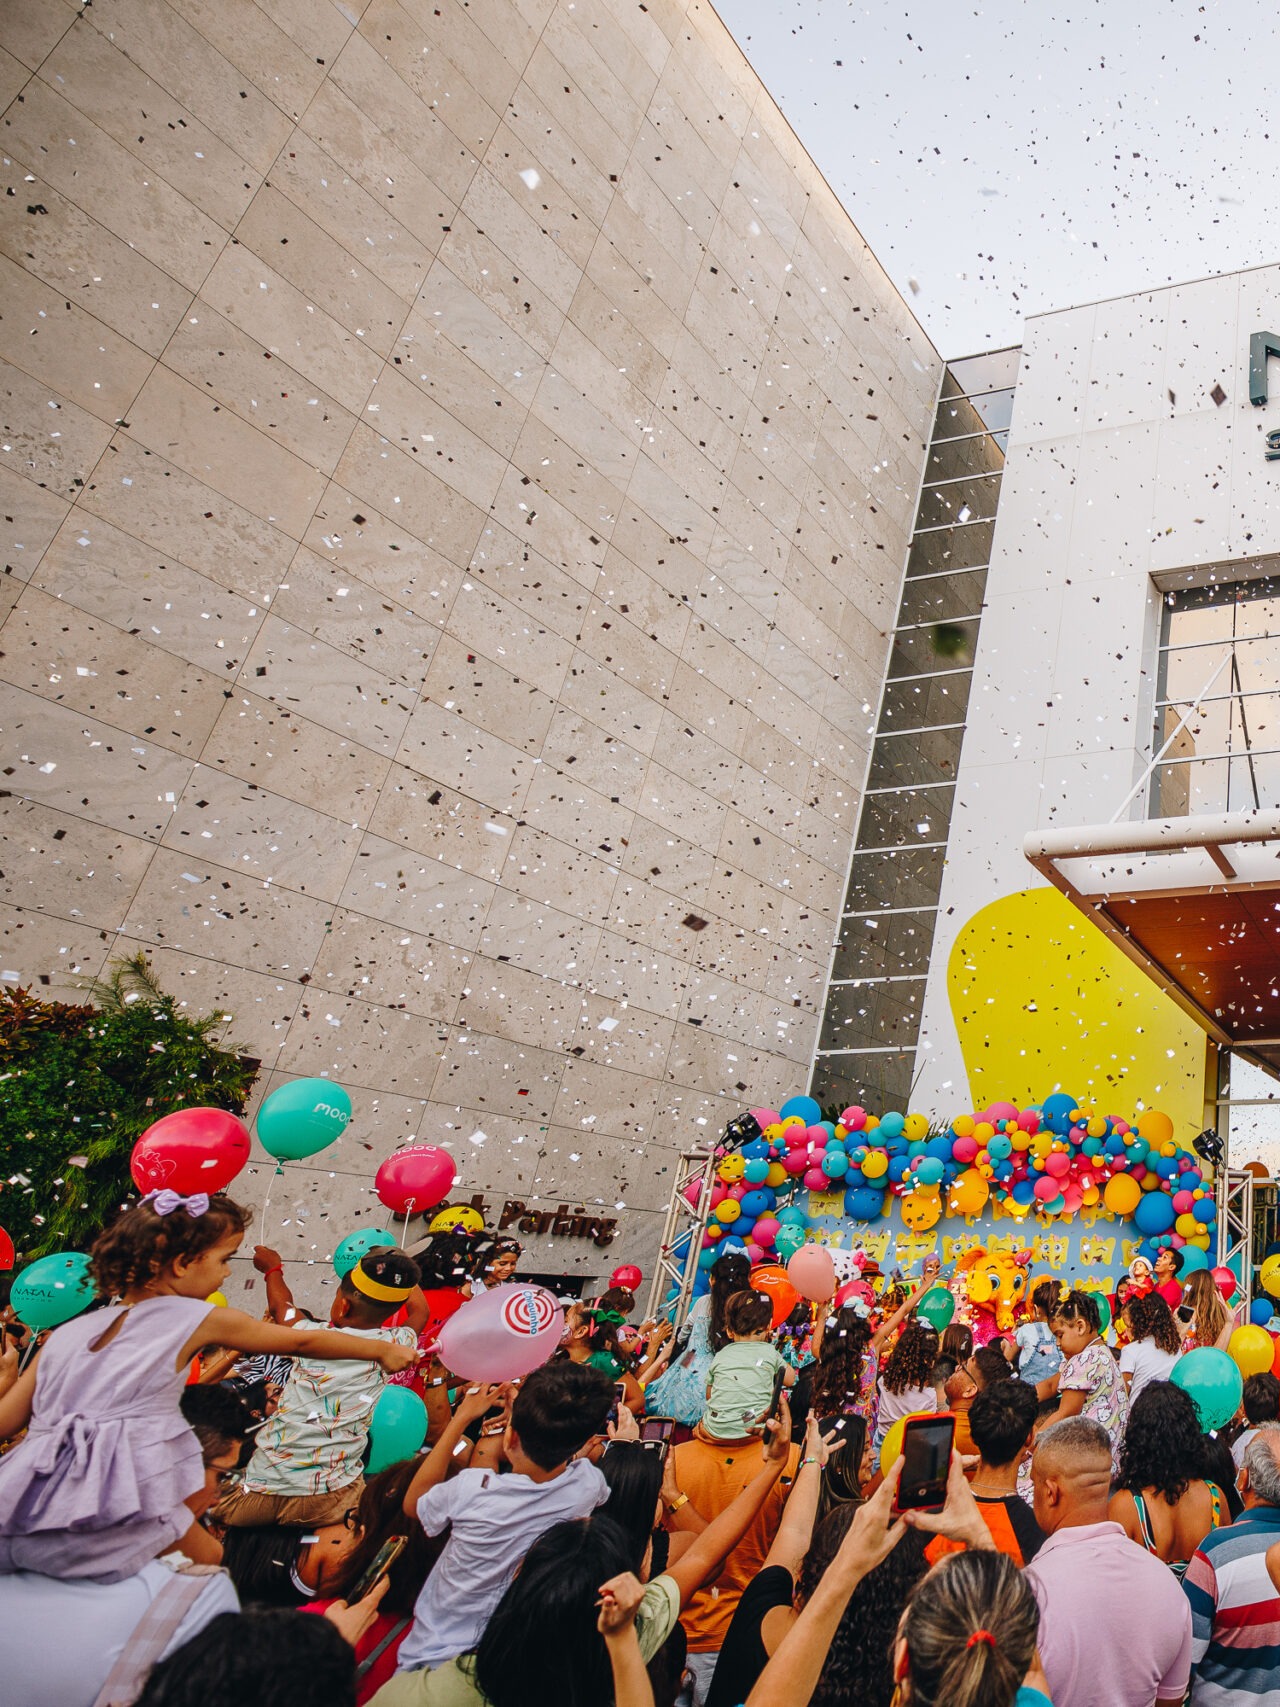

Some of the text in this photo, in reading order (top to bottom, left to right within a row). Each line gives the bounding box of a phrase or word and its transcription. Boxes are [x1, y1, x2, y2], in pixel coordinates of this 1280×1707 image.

[497, 1199, 619, 1247] Parking
[14, 1287, 56, 1298] NATAL
[522, 1290, 539, 1335] Chiquinho
